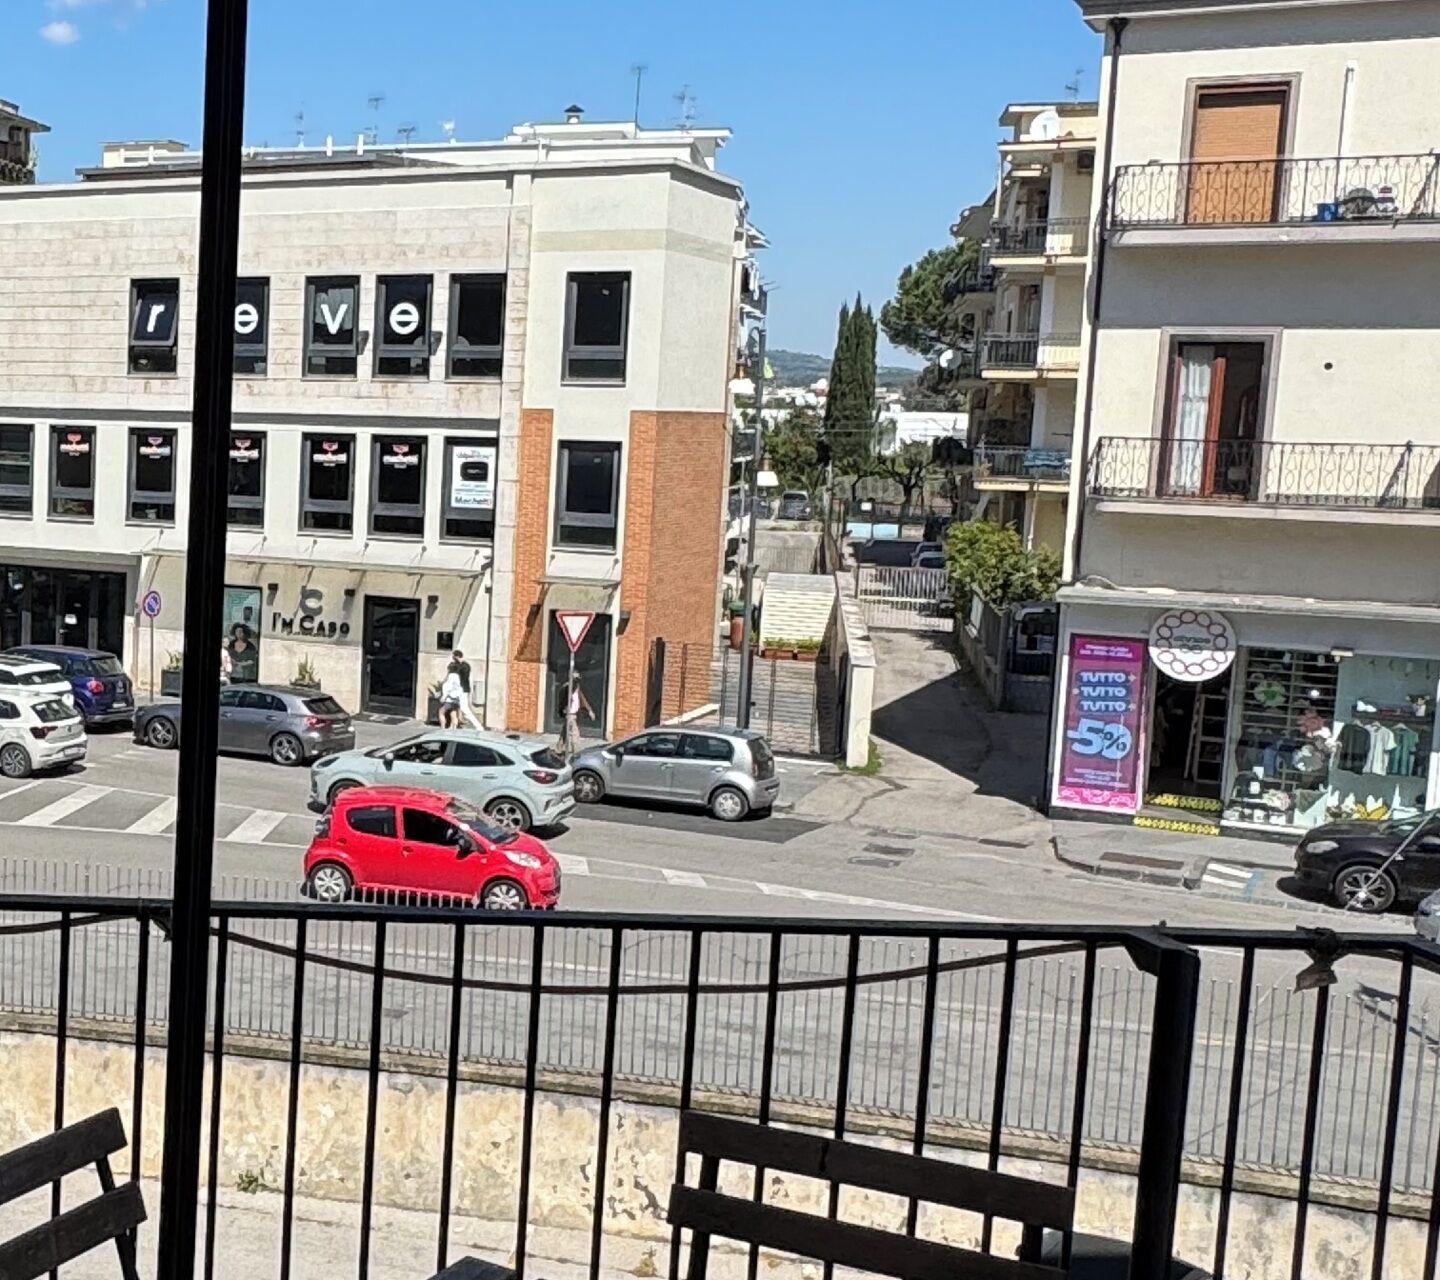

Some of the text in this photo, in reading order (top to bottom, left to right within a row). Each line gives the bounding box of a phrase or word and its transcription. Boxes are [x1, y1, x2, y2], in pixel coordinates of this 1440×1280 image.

[147, 302, 420, 335] reve
[1080, 672, 1126, 683] TUTTO
[1080, 686, 1127, 697] TUTTO
[1080, 701, 1126, 712] TUTTO
